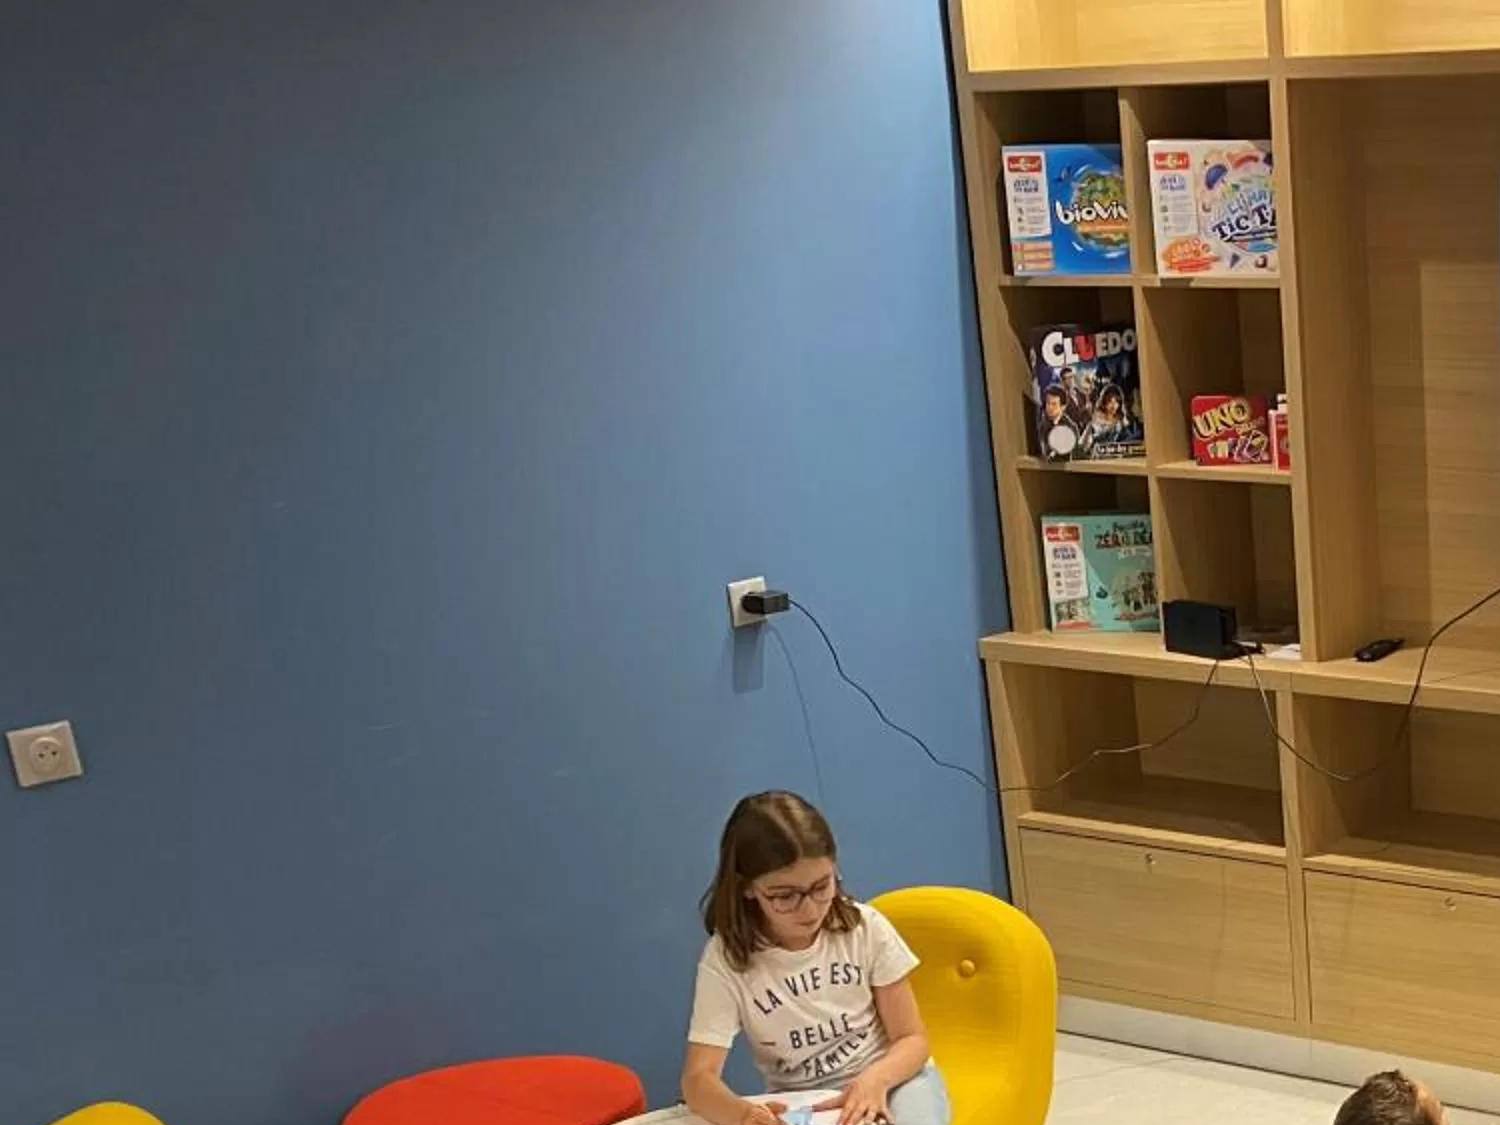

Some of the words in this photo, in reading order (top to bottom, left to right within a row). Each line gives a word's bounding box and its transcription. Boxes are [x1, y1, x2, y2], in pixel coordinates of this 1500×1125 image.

[1042, 328, 1137, 367] CLUEDO
[1193, 398, 1250, 440] UNO
[753, 988, 783, 1015] LA
[784, 967, 821, 997] VIE
[831, 962, 862, 985] EST
[789, 1012, 853, 1050] BELLE
[802, 1024, 873, 1078] FAMILL
